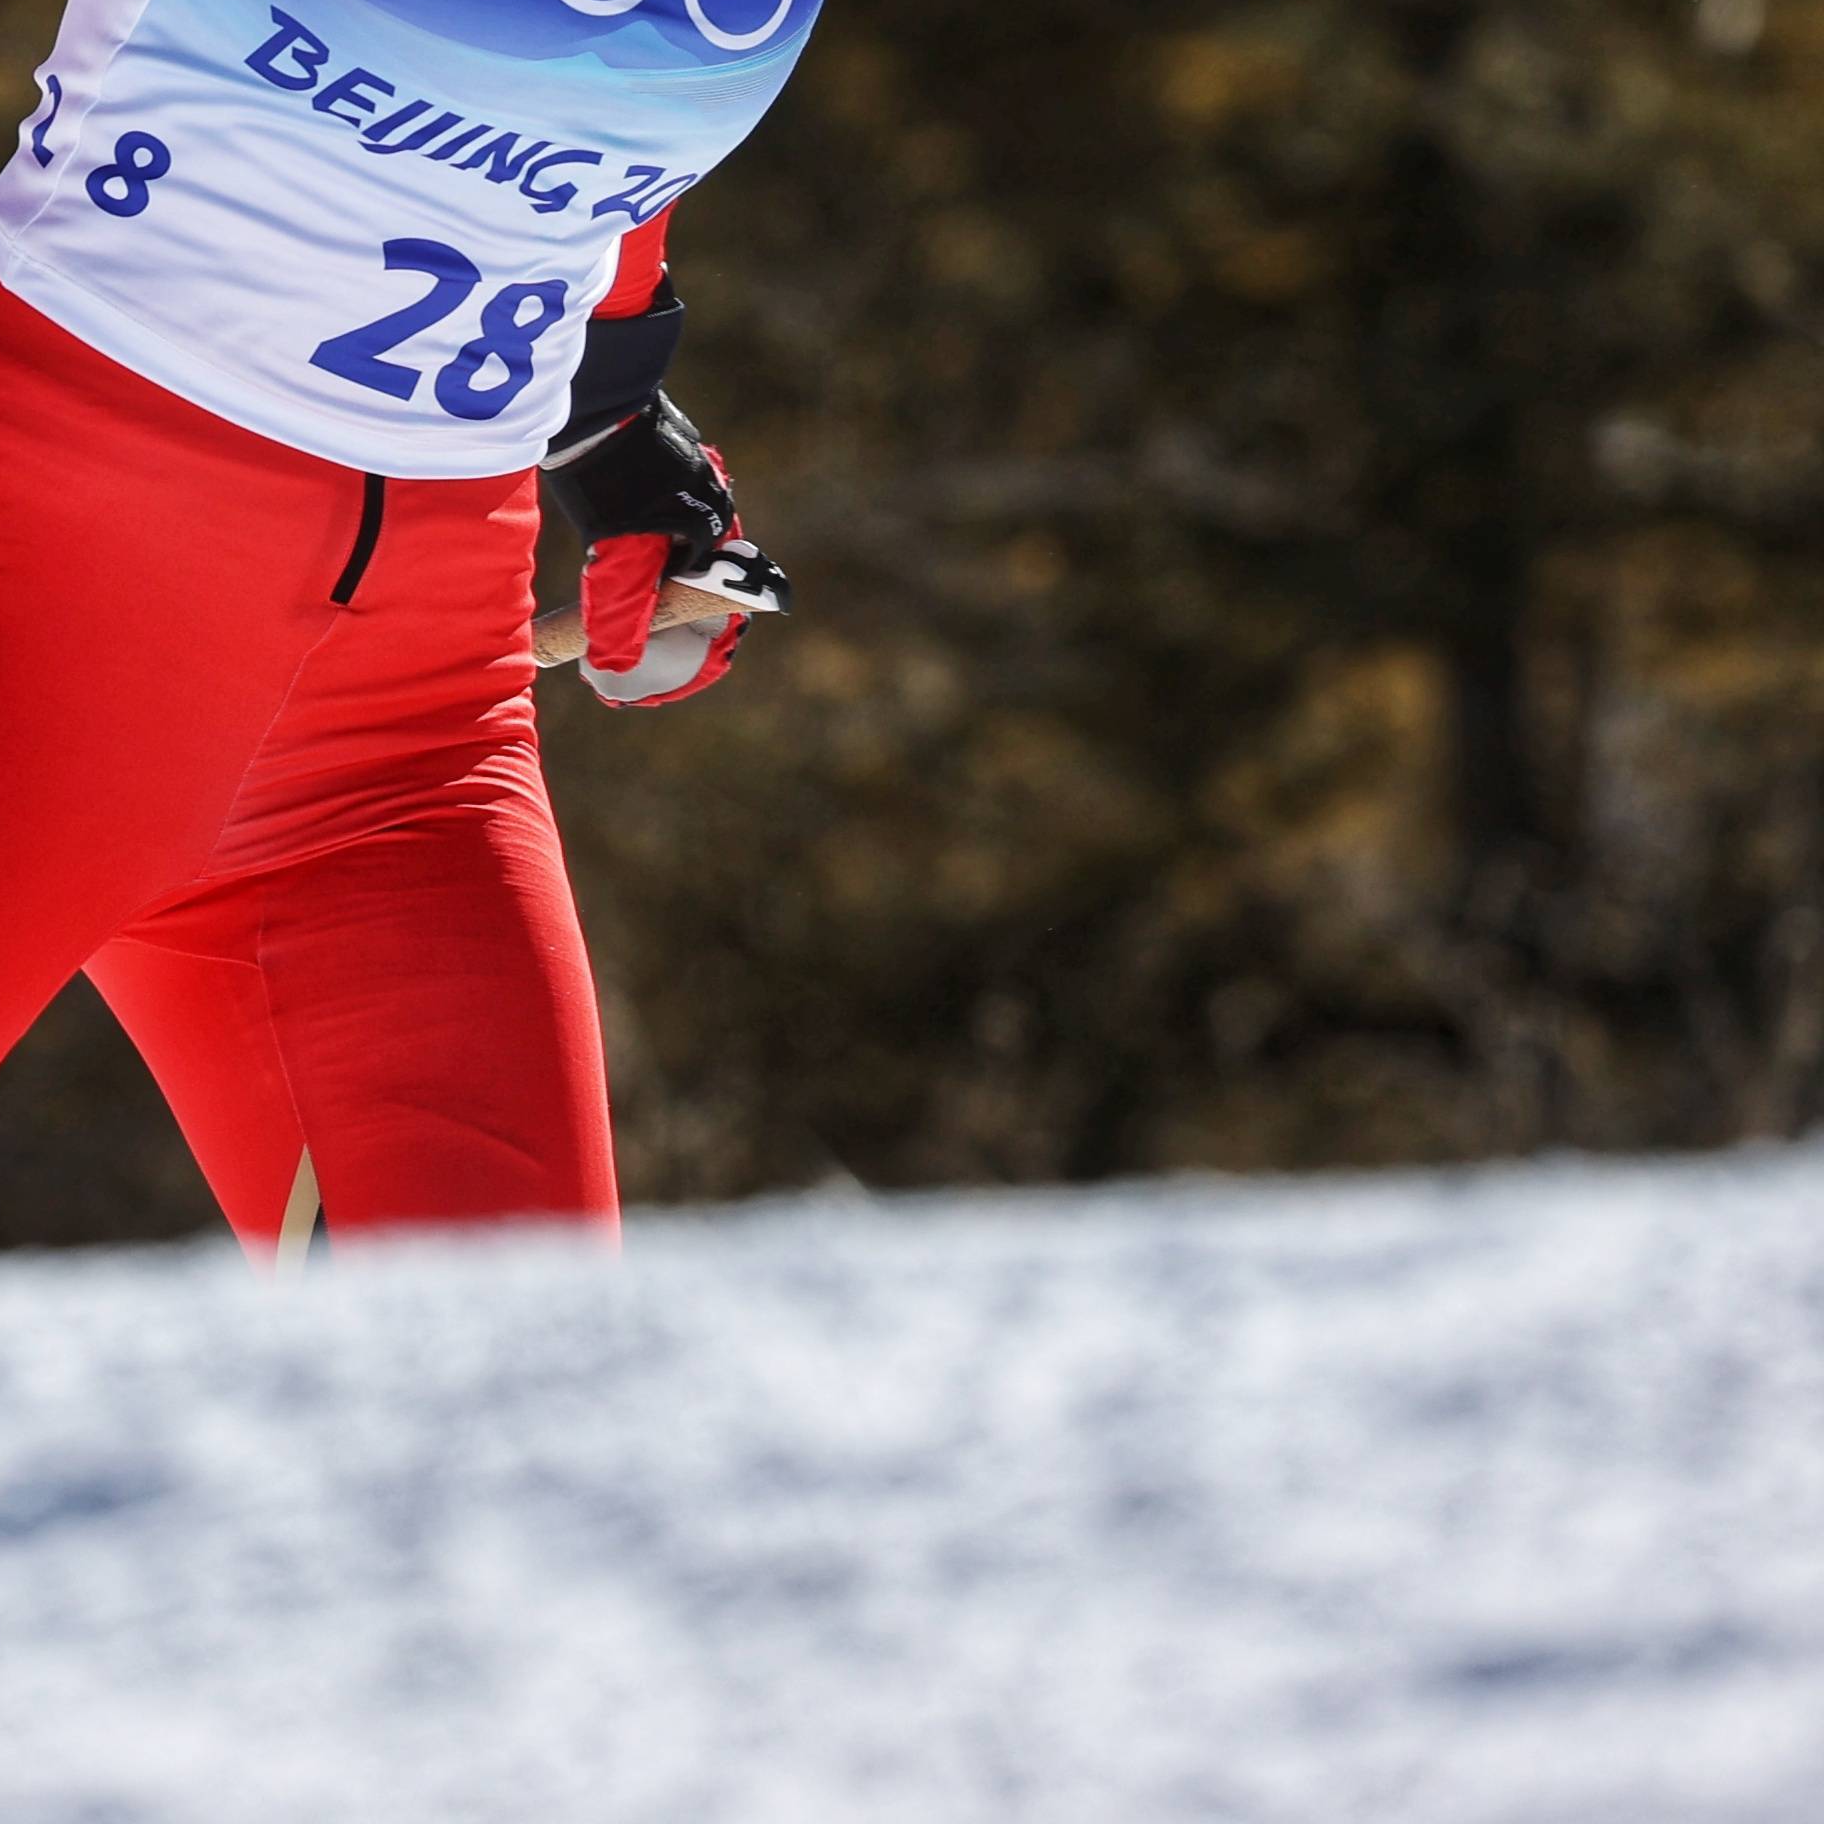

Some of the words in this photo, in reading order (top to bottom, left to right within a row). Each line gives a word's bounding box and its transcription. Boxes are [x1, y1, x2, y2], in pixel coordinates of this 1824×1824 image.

[244, 5, 603, 213] BEIJING
[591, 165, 698, 226] 20
[308, 237, 569, 421] 28
